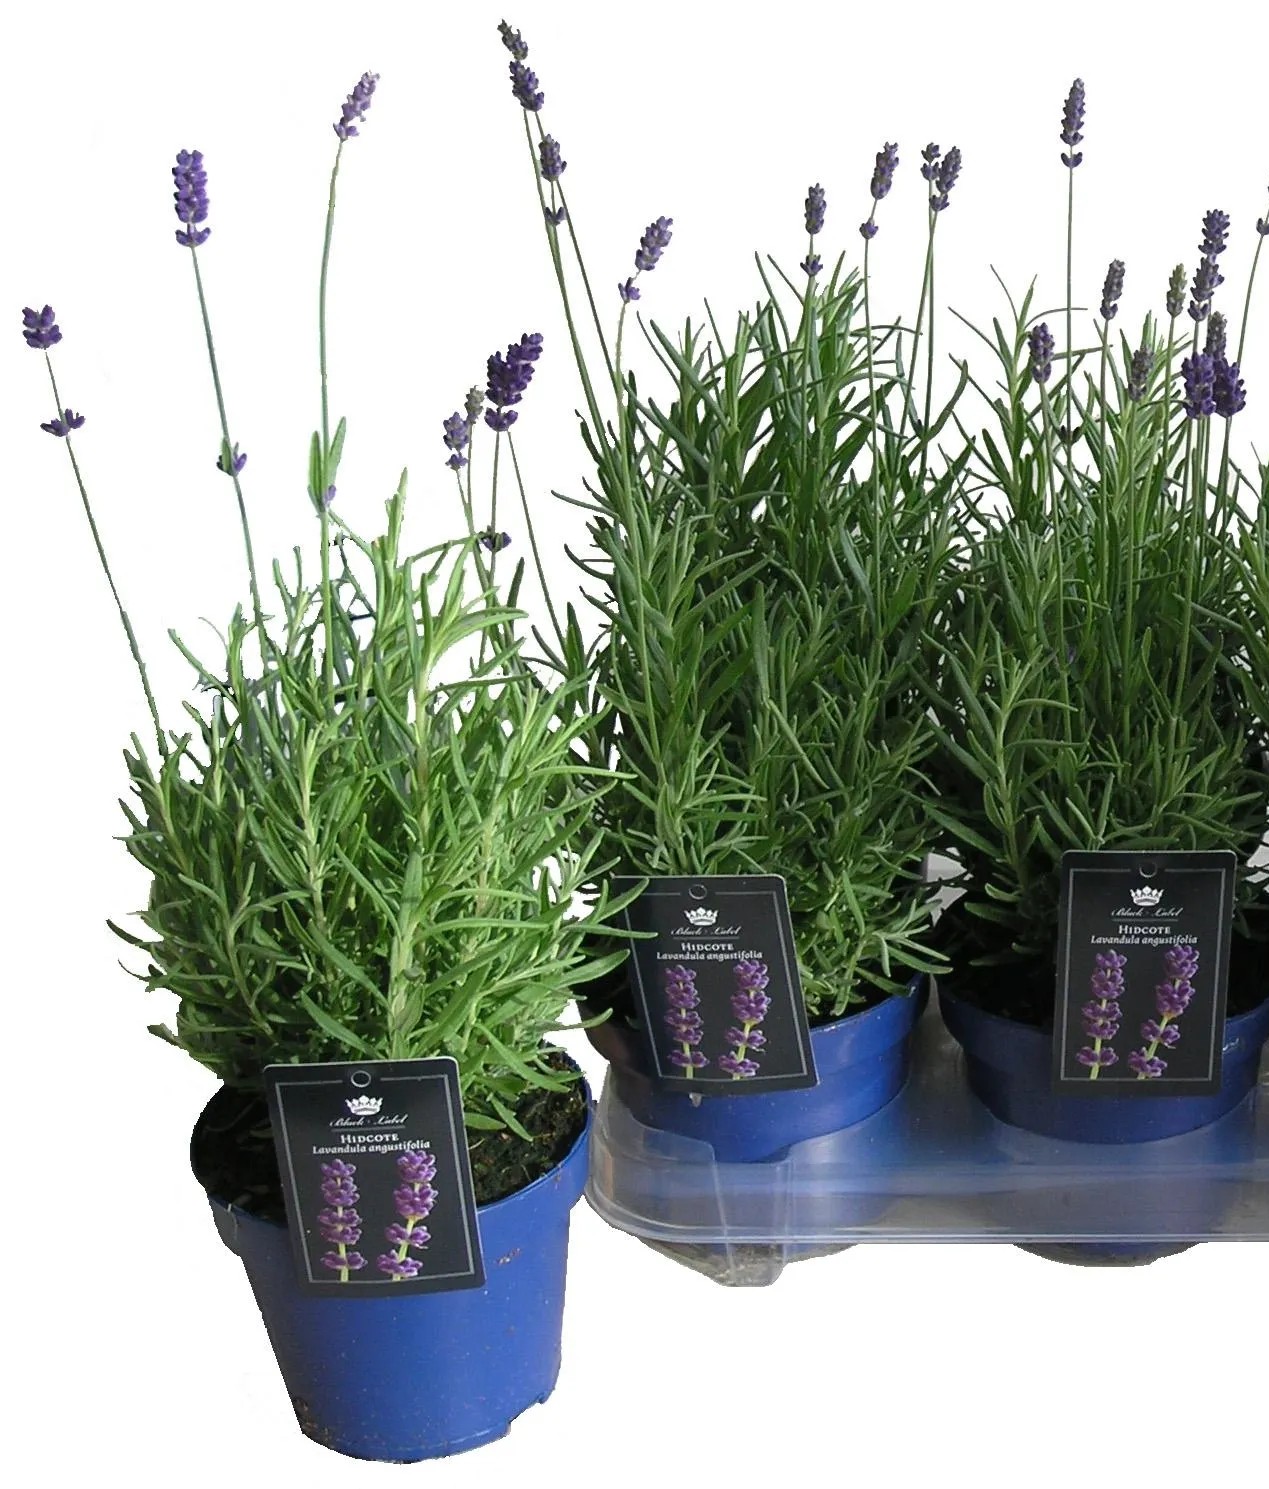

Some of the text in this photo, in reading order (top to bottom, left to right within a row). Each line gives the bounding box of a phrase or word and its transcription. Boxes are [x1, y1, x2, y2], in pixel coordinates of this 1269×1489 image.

[1111, 907, 1184, 917] Black Label
[1118, 924, 1172, 935] HIDCOTE
[1091, 934, 1198, 947] Lavandula angustifolia
[656, 950, 763, 962] Lavandula angustifolia
[312, 1140, 431, 1155] Lavandula angustifolia
